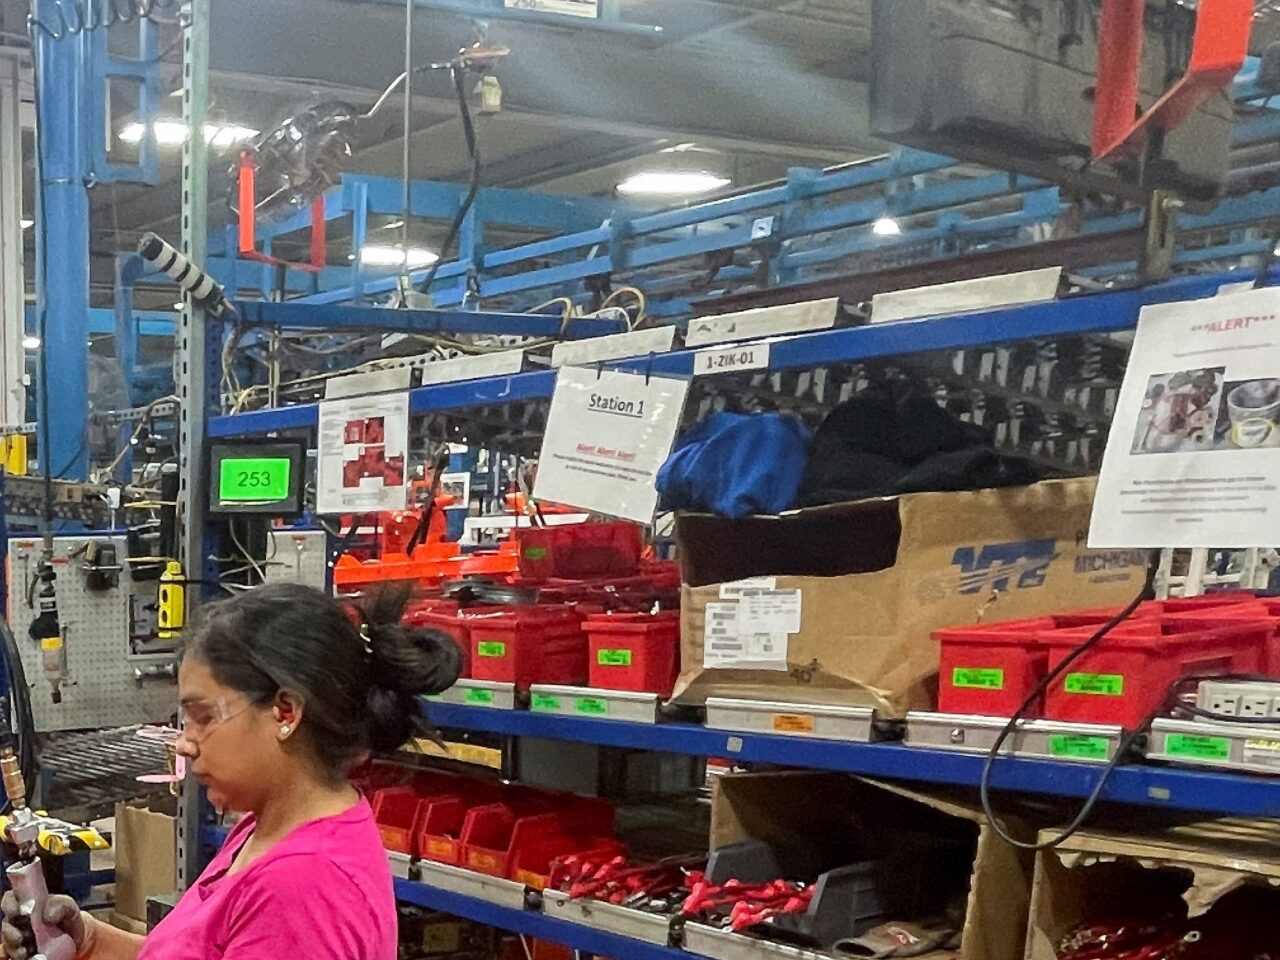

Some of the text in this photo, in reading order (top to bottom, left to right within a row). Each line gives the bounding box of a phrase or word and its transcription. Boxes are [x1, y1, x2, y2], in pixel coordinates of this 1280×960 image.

[589, 393, 644, 414] Station 1
[238, 471, 271, 487] 253
